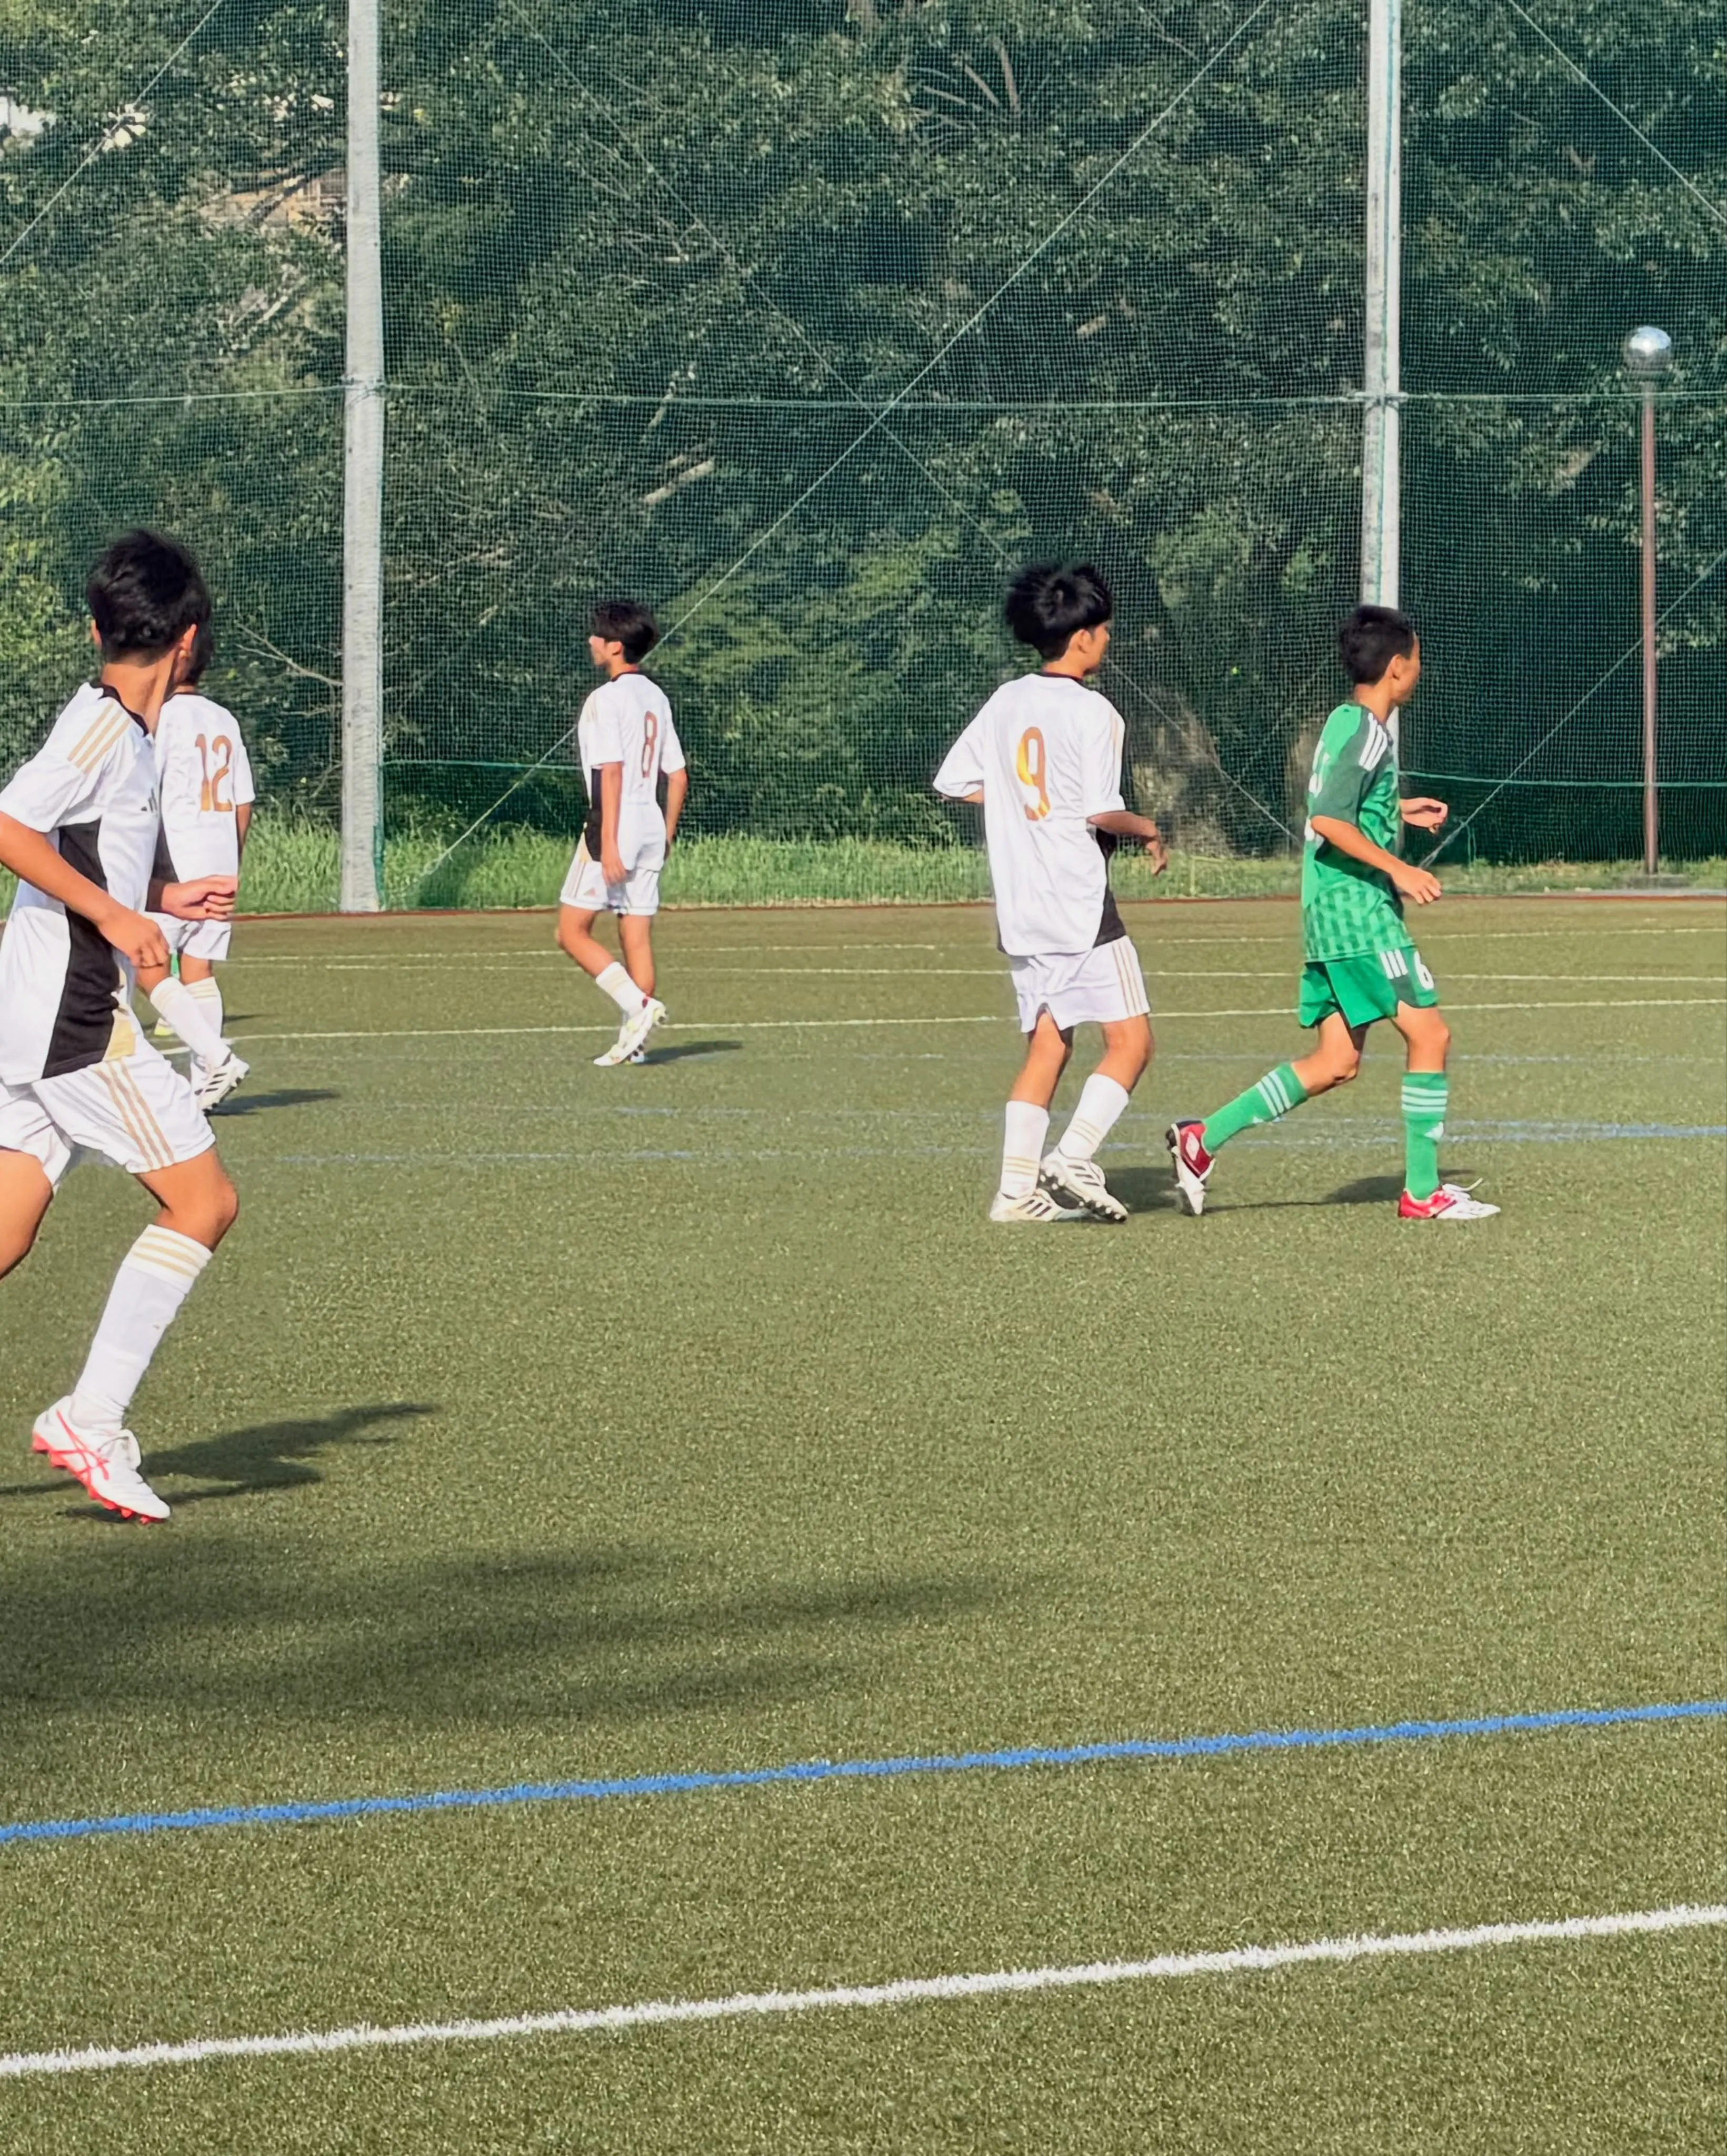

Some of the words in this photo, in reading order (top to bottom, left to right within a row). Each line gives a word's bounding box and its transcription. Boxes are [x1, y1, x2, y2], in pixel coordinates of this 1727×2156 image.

[194, 733, 233, 812] 12
[641, 711, 657, 778] 8
[1016, 726, 1050, 822] 9
[1413, 950, 1434, 990] 6
